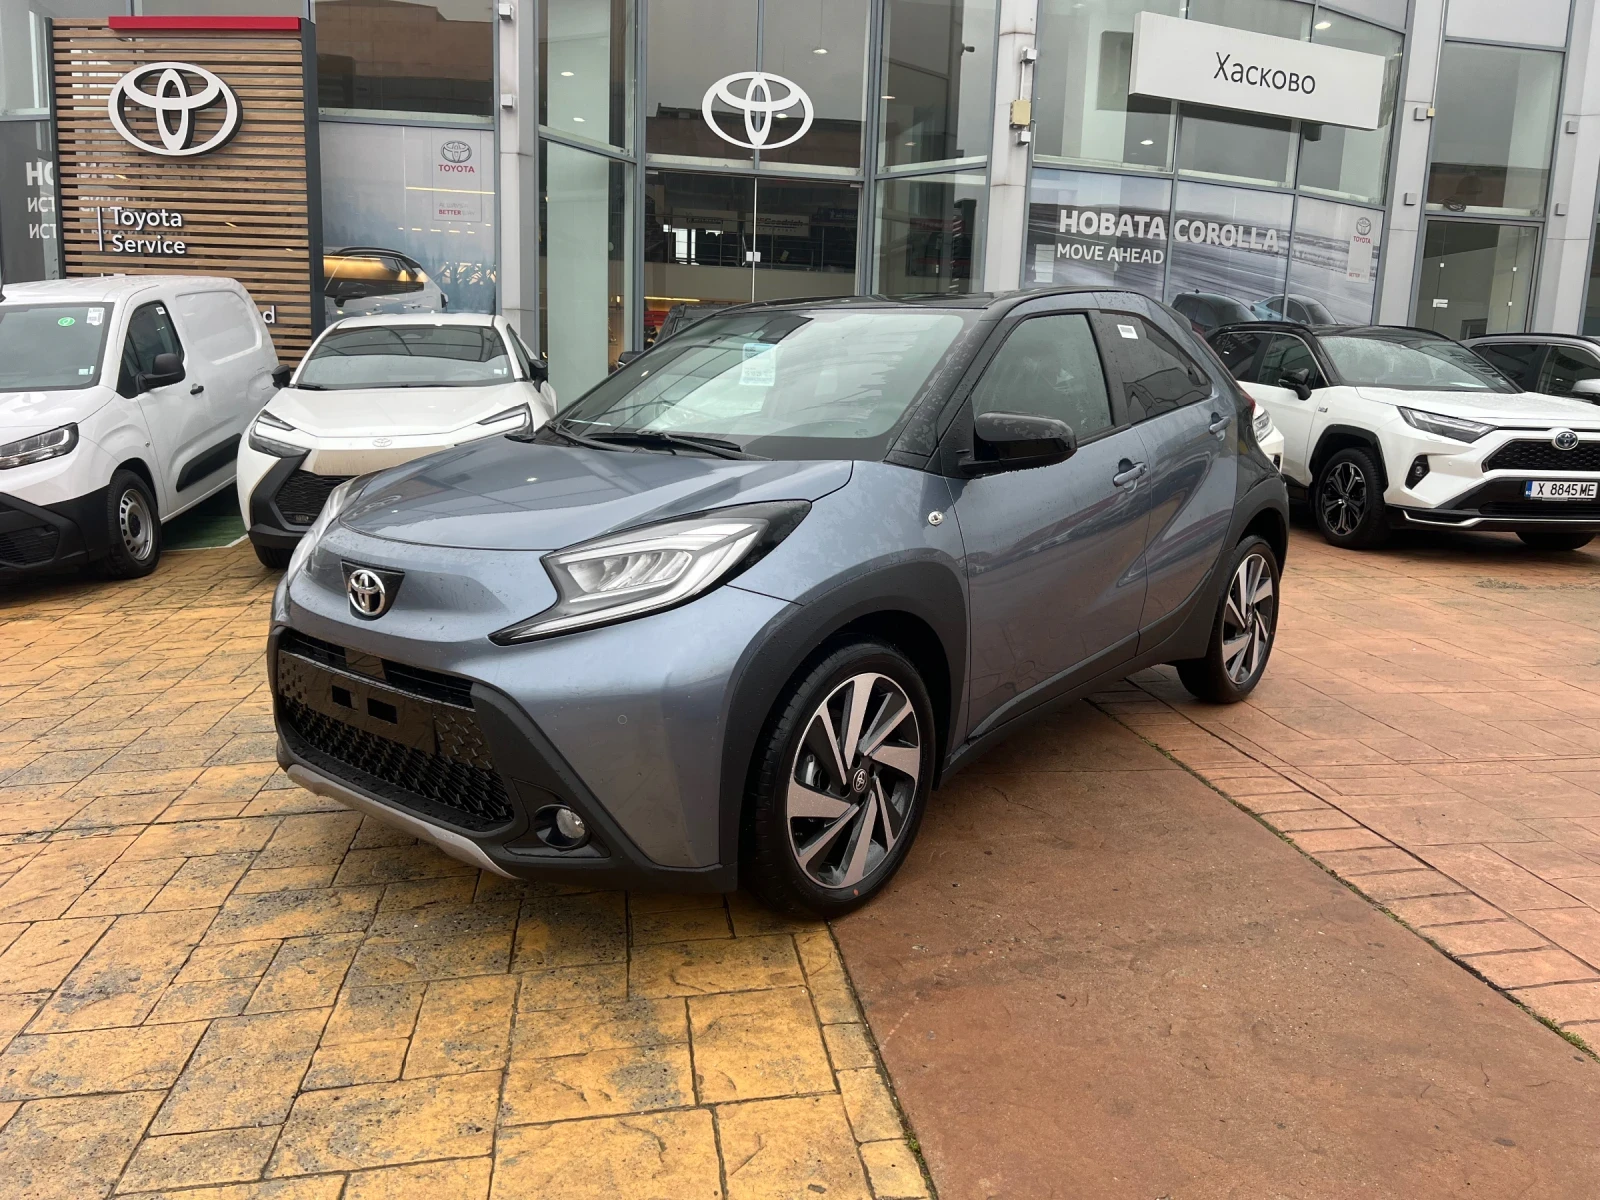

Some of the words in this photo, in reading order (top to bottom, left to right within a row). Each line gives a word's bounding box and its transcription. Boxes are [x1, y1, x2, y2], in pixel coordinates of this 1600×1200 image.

[1213, 51, 1316, 94] Хасково
[437, 164, 475, 173] TOYOTA
[109, 206, 183, 230] Toyota
[112, 234, 186, 254] Service
[1173, 219, 1279, 252] COROLLA
[1353, 235, 1371, 244] TOYOTA
[1057, 243, 1104, 261] MOVE
[1107, 246, 1164, 264] AHEAD
[1550, 483, 1578, 496] 8845
[1579, 483, 1596, 497] ME
